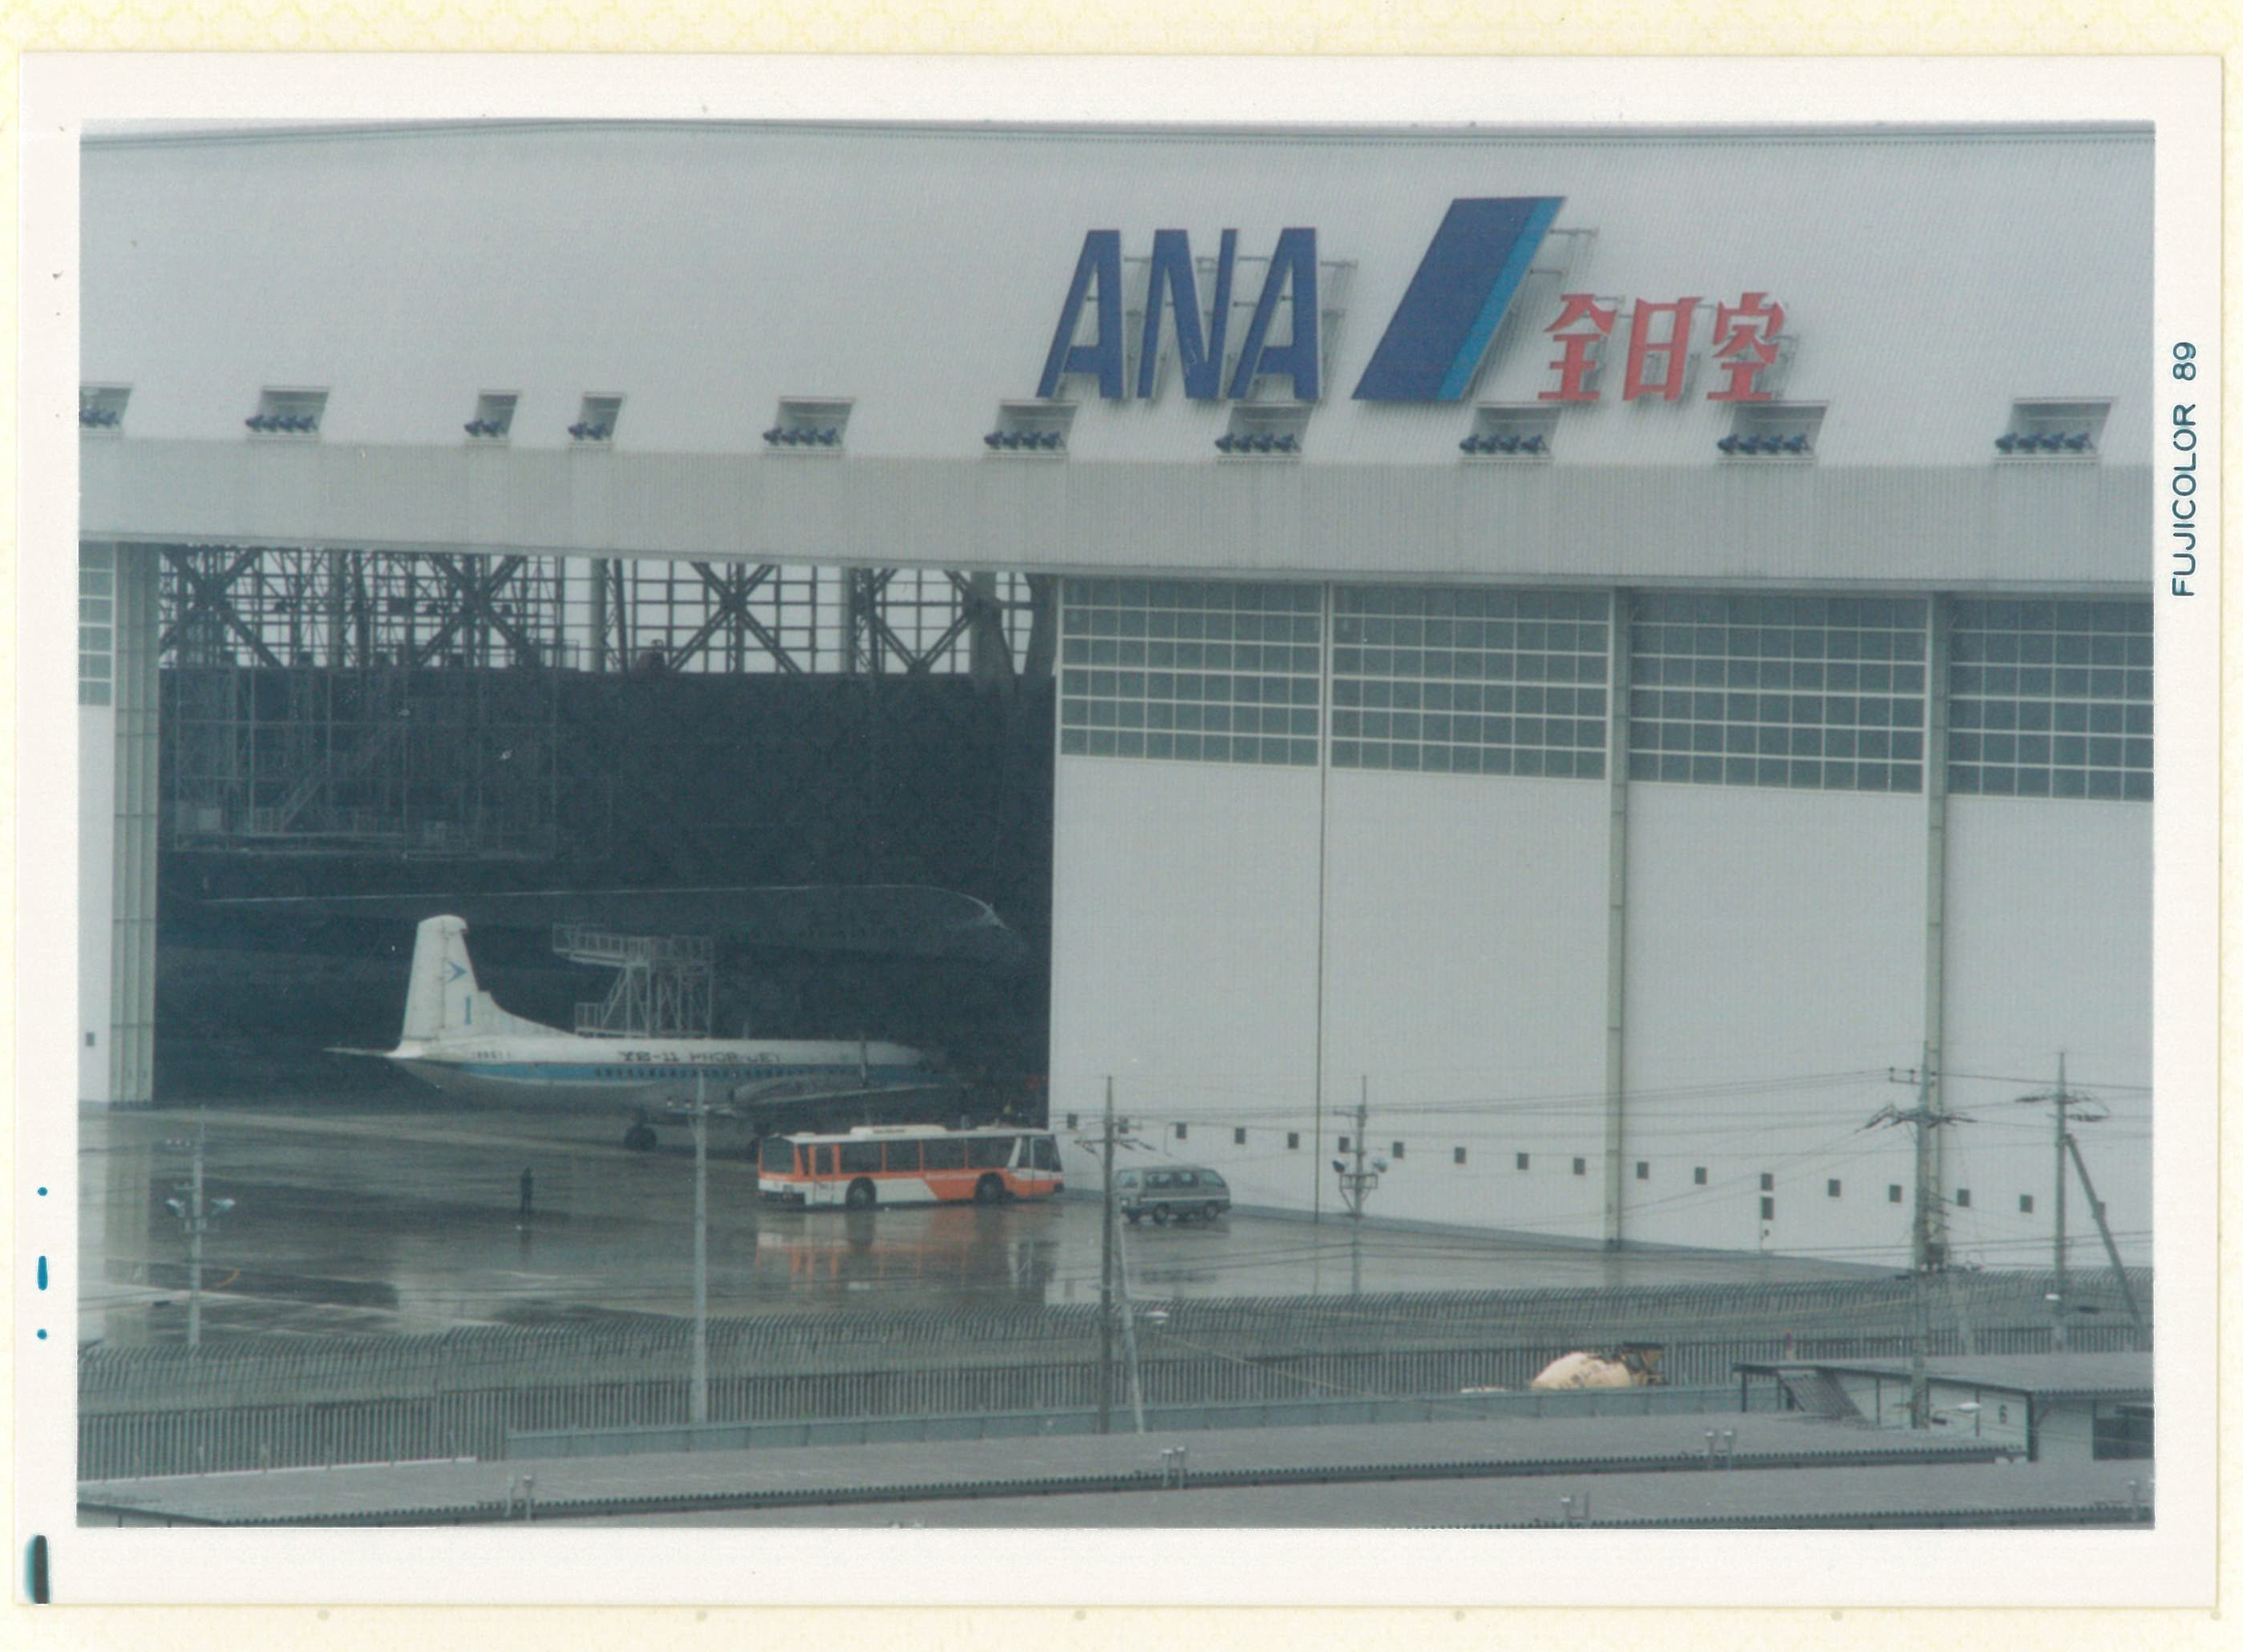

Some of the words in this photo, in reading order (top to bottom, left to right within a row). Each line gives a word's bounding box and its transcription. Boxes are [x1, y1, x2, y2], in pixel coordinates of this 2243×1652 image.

[1036, 227, 1322, 400] ANA
[1537, 292, 1786, 402] 全日空
